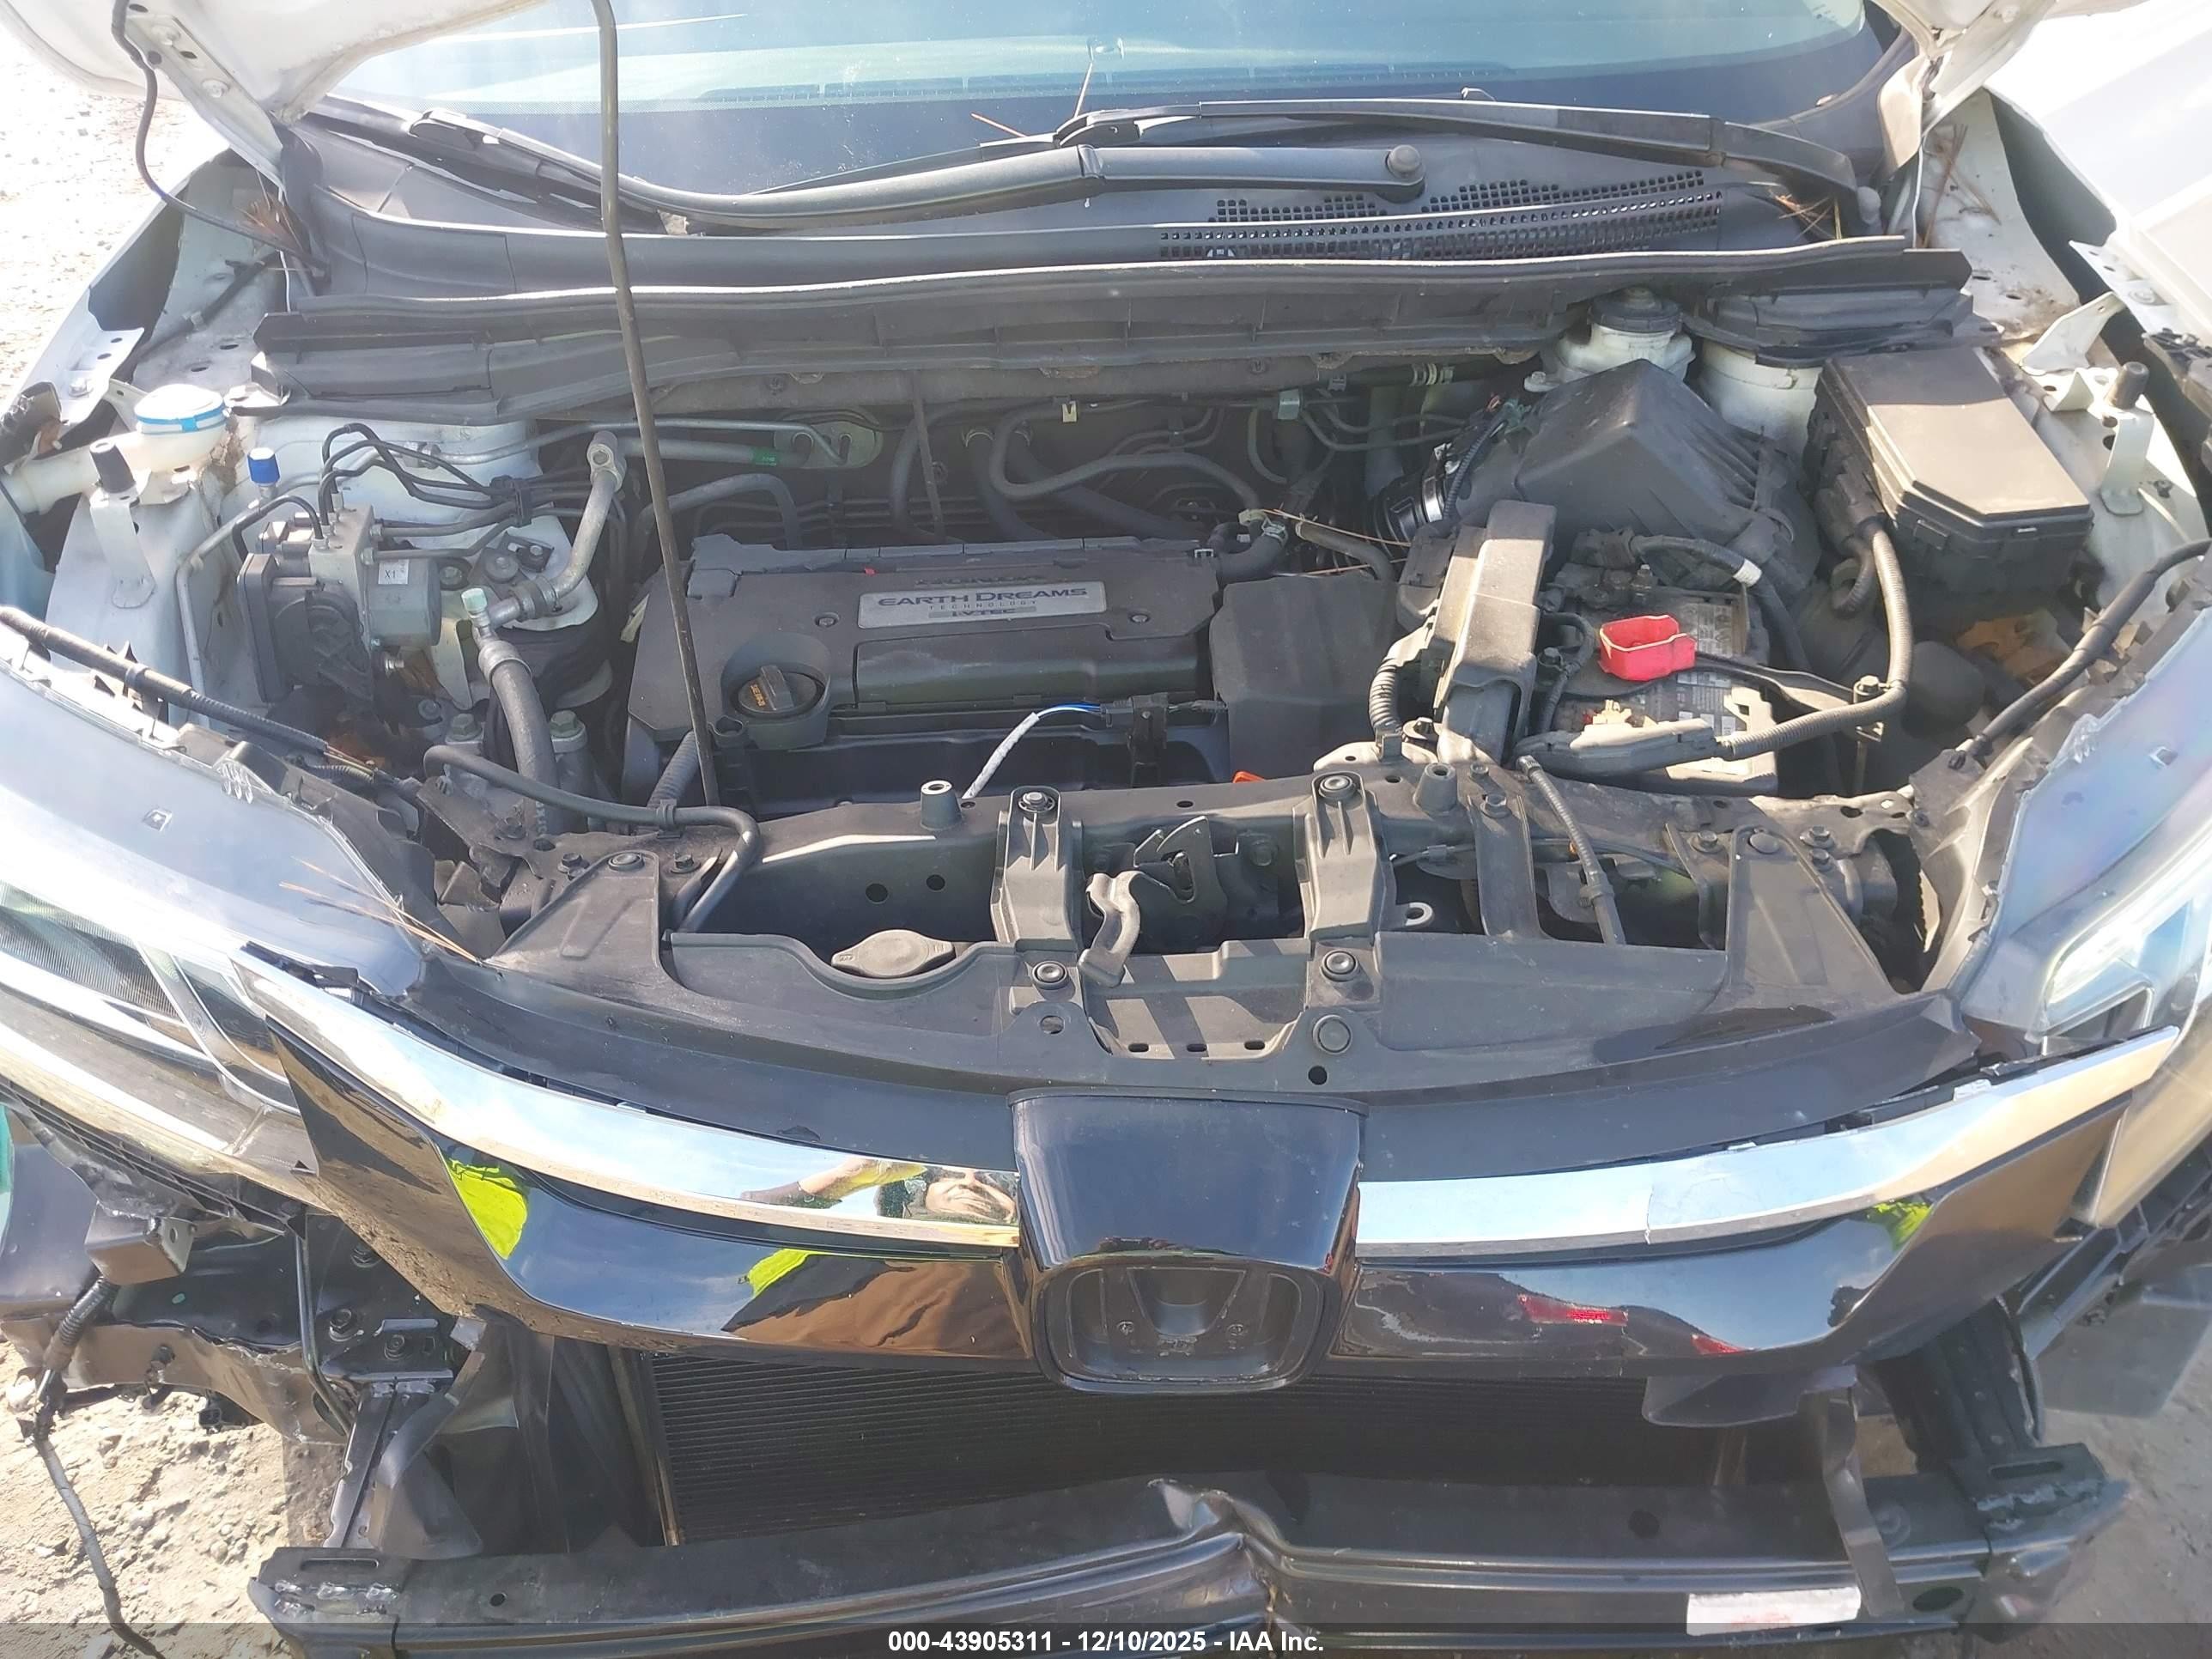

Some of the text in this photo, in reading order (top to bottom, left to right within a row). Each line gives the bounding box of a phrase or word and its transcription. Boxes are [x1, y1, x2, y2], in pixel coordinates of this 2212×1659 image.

[878, 588, 1088, 606] EARTH DREAMS
[930, 600, 1037, 611] TECHNOLOGY
